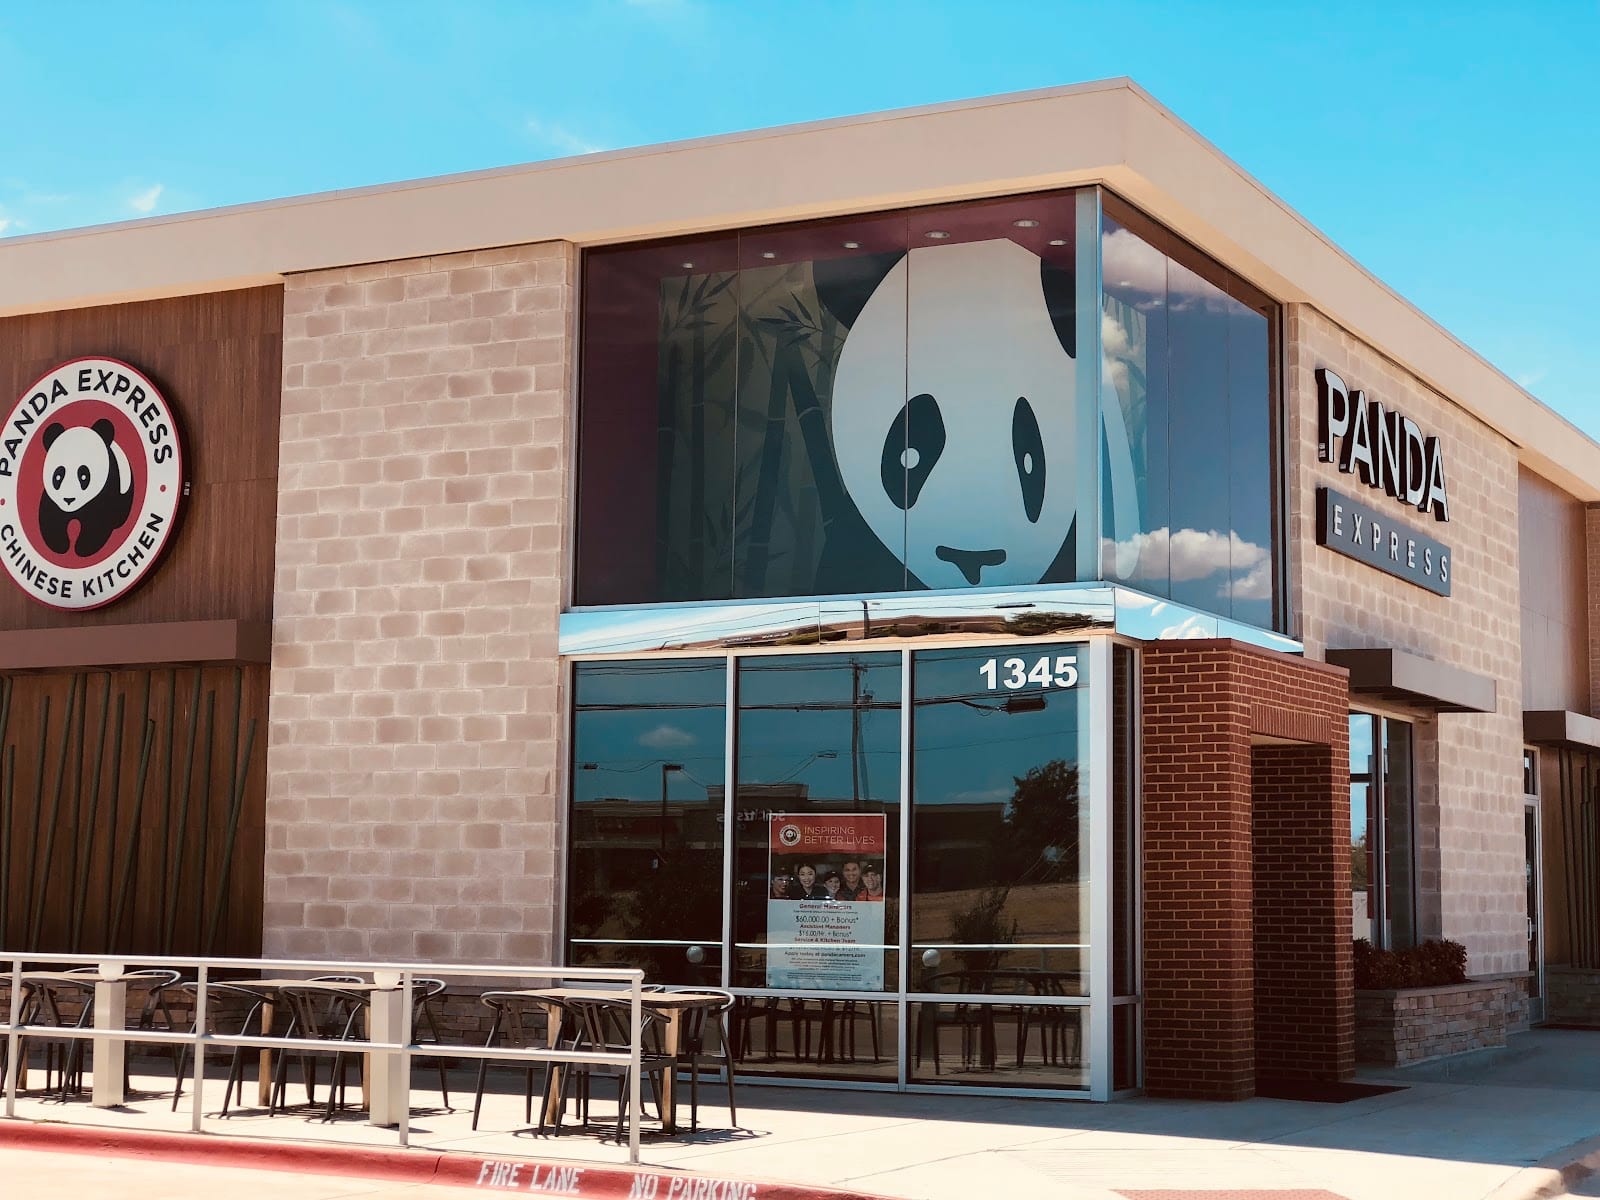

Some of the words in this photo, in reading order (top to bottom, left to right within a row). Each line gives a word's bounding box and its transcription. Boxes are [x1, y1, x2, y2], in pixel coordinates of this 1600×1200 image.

[0, 379, 68, 477] PANDA
[78, 369, 172, 464] EXPRESS
[1315, 368, 1449, 522] PANDA
[0, 524, 72, 598] CHINESE
[83, 512, 164, 597] KITCHEN
[1332, 504, 1448, 583] EXPRESS
[980, 656, 1078, 689] 1345
[804, 826, 855, 835] INSPIRING
[804, 835, 844, 845] BETTER
[846, 836, 876, 845] LIVES
[476, 1160, 525, 1187] FIRE
[529, 1164, 584, 1195] LANE
[628, 1172, 660, 1200] NO
[668, 1175, 757, 1200] PARKING
